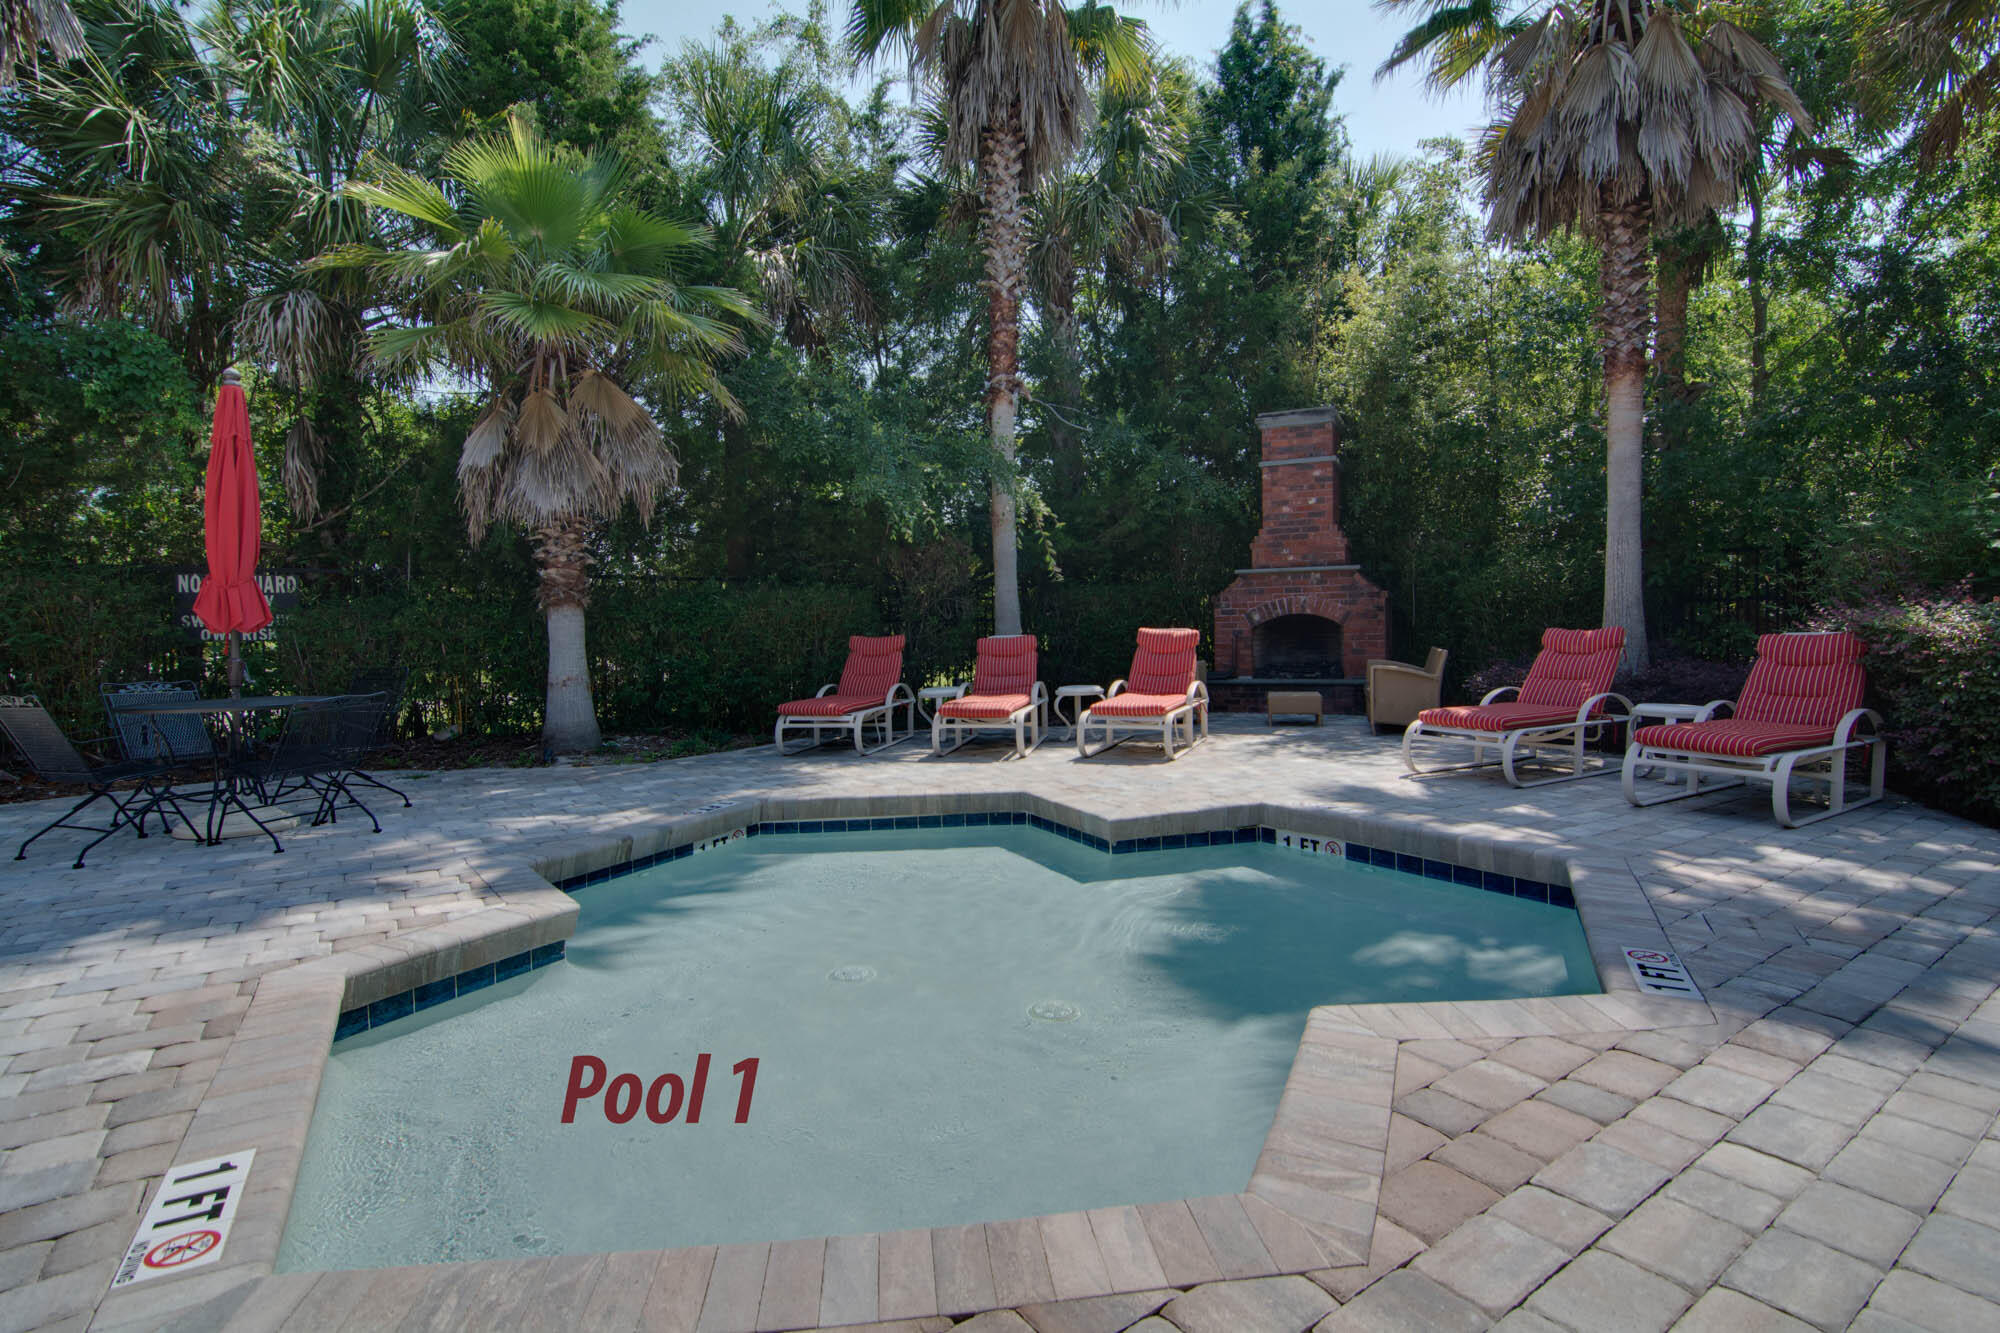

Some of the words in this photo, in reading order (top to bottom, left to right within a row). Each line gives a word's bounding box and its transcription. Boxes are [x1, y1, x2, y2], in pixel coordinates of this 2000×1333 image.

[177, 574, 201, 593] NO
[1283, 835, 1291, 847] 1
[1300, 837, 1320, 852] FT
[1637, 963, 1685, 982] FT
[1646, 983, 1692, 992] 1
[173, 1162, 238, 1185] 1
[152, 1185, 231, 1230] FT
